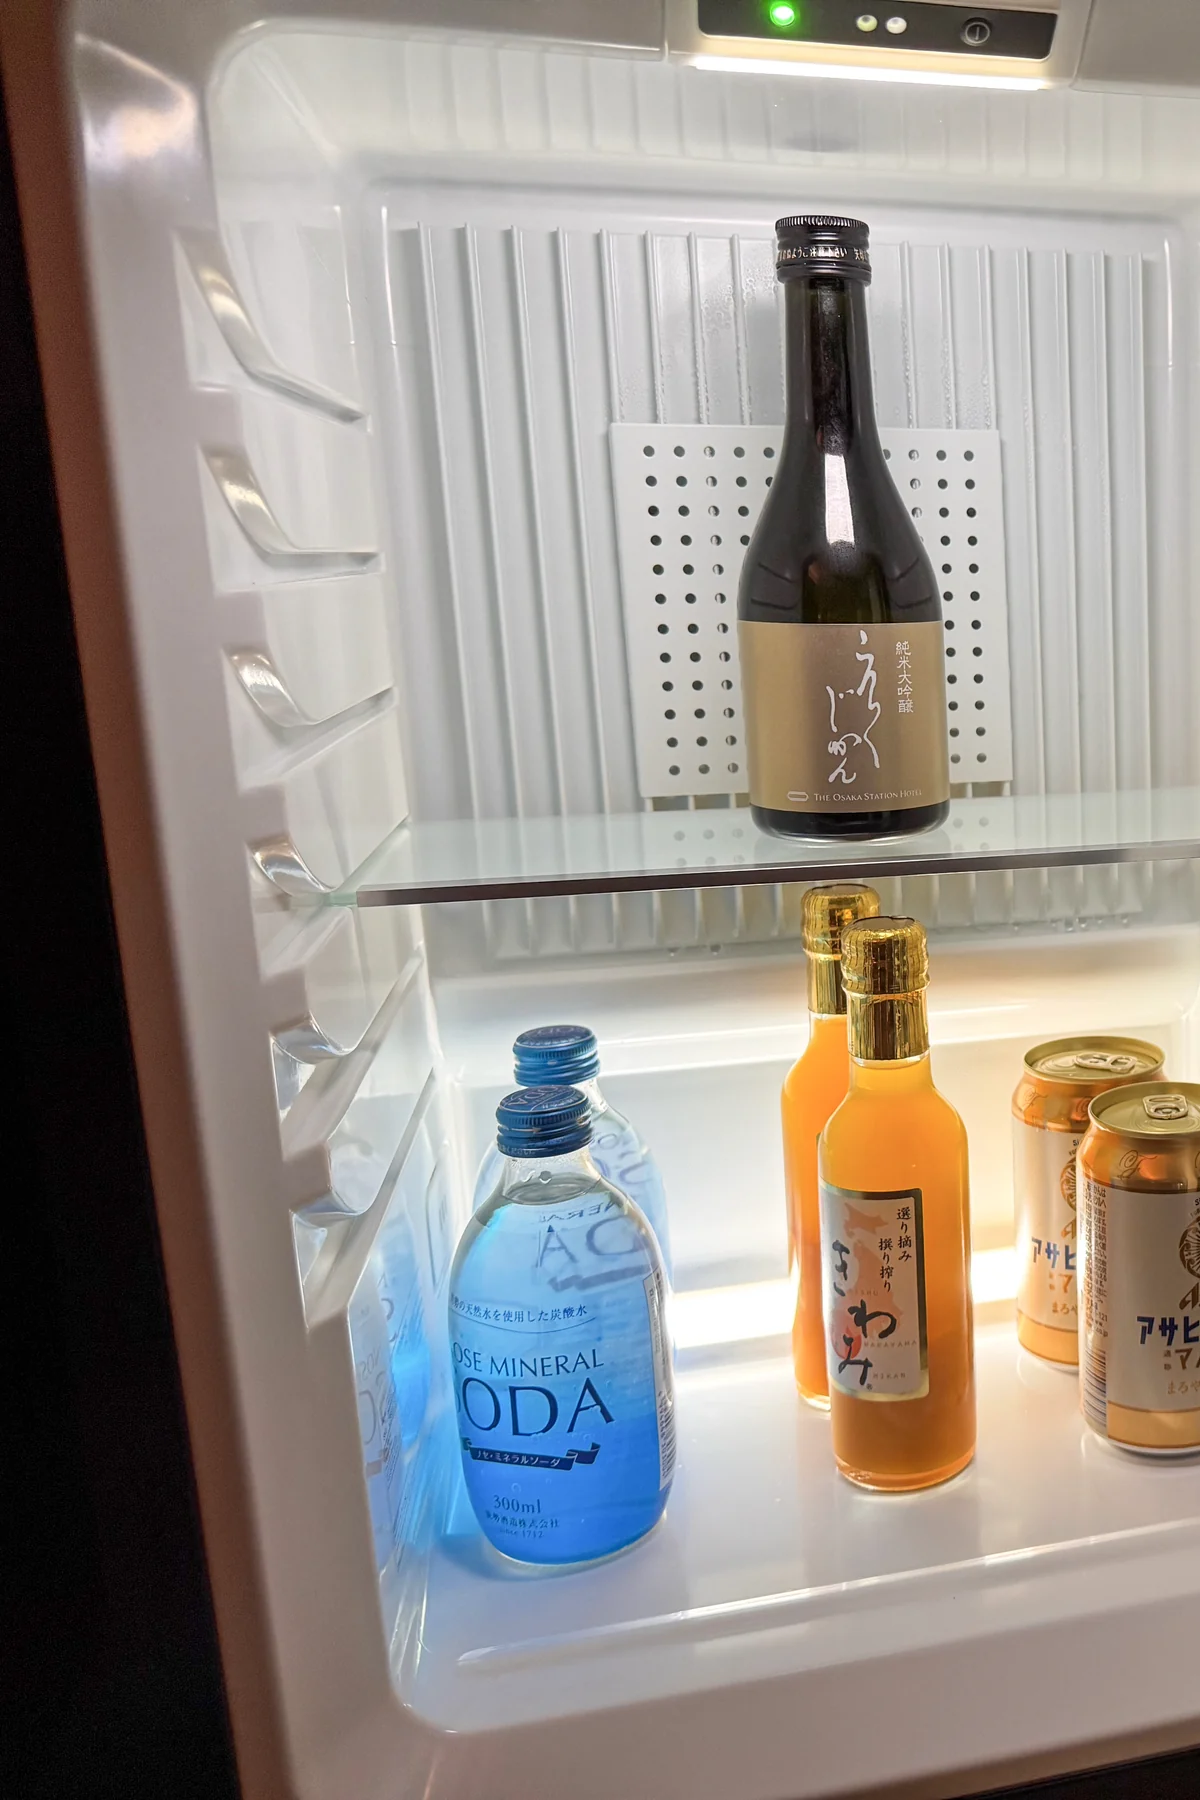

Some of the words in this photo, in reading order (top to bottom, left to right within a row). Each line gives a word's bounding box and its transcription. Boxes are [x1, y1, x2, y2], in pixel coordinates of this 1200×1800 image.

[895, 641, 914, 713] 純米大吟醸
[813, 793, 830, 801] THE
[832, 793, 863, 801] OSAKA
[863, 792, 899, 801] STATION
[896, 1206, 912, 1262] 選り摘み
[878, 1237, 894, 1293] 撰り搾り
[452, 1342, 482, 1372] OSE
[490, 1348, 605, 1377] MINERAL
[457, 1377, 615, 1436] ODA
[494, 1494, 541, 1513] 300ml
